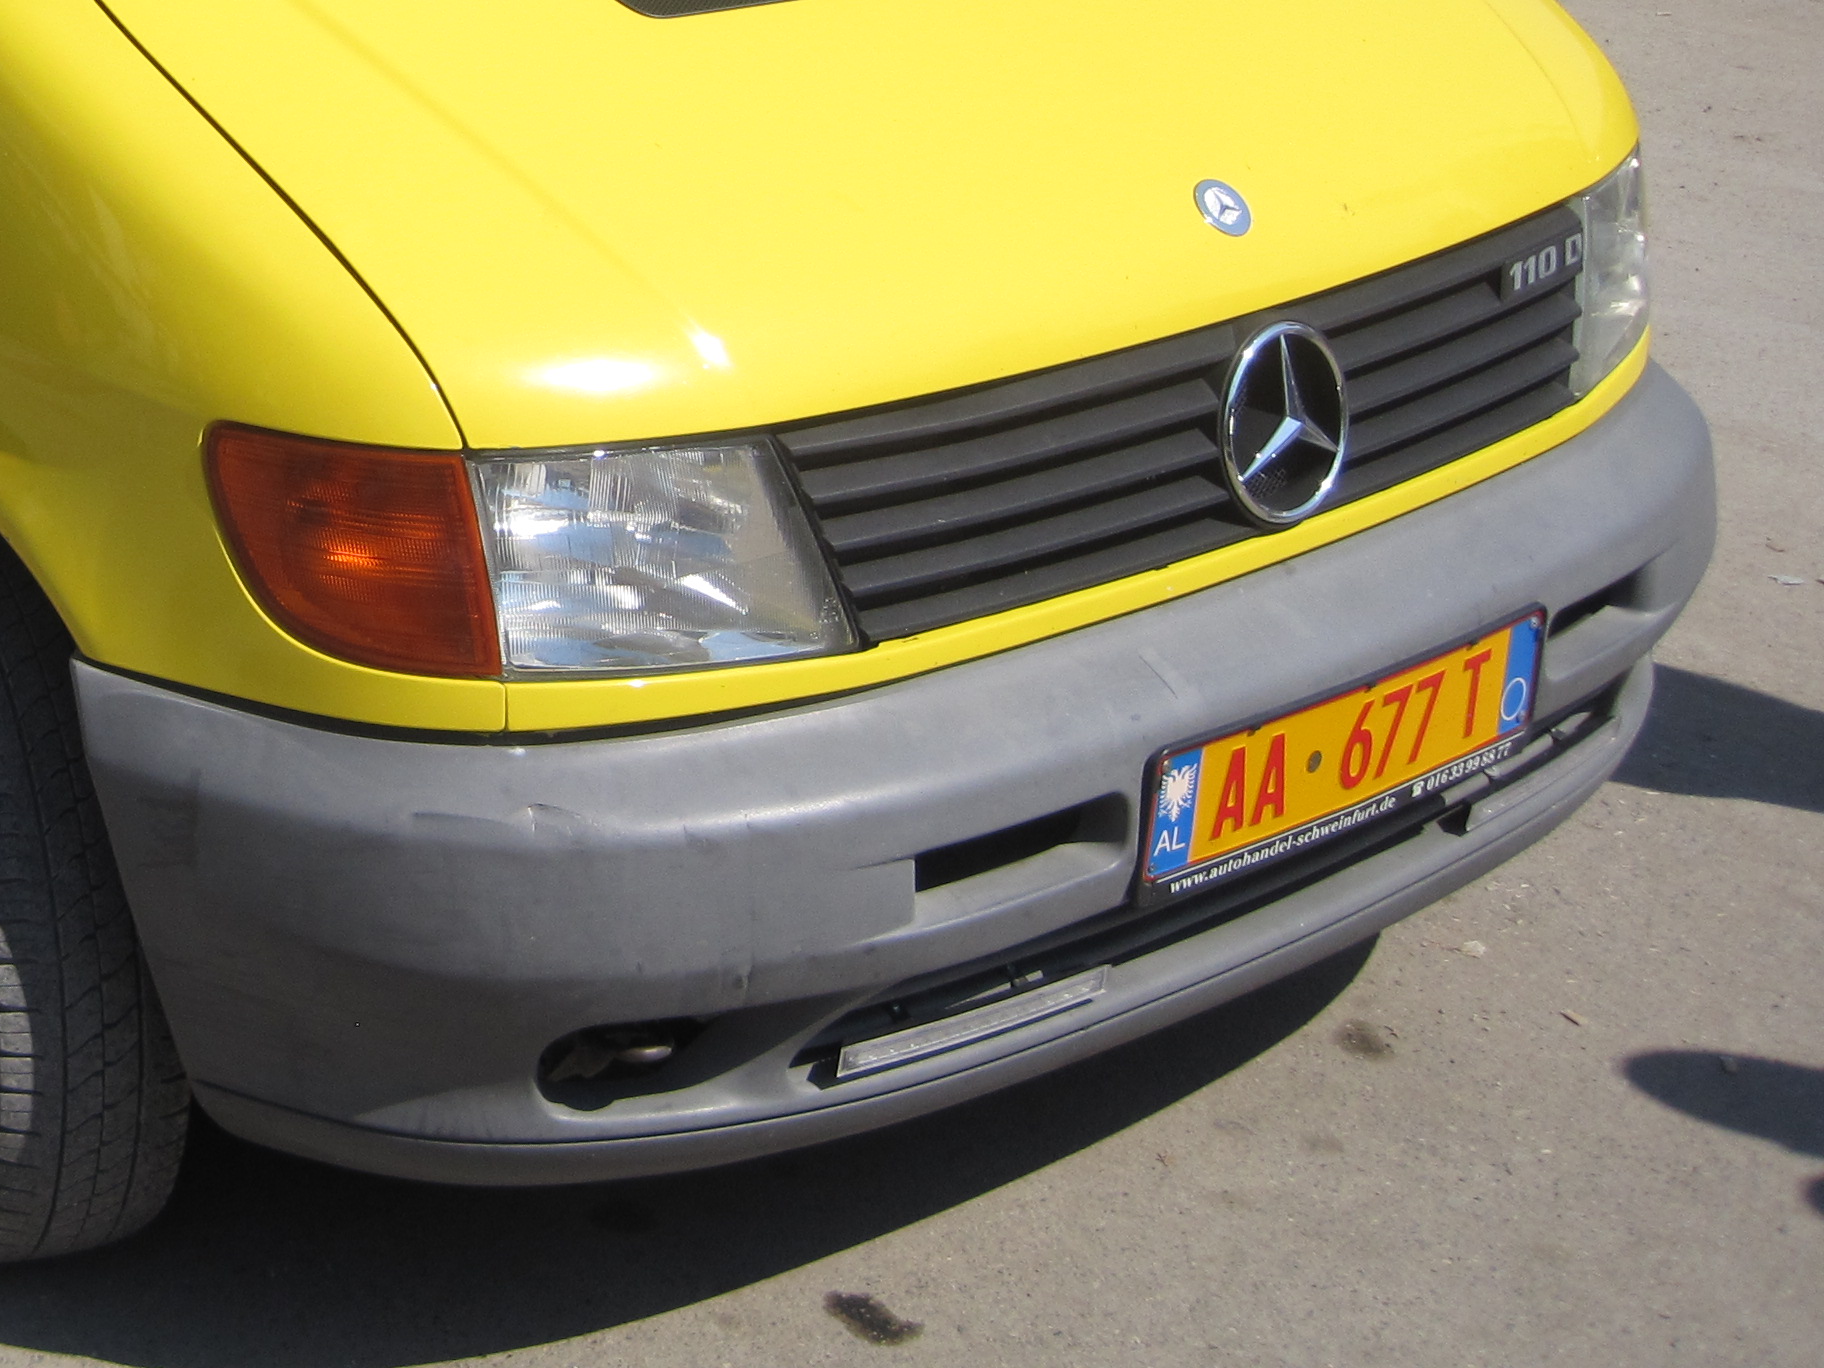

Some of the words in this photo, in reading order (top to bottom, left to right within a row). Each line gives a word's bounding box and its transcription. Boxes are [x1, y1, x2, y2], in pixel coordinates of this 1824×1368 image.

[1509, 245, 1557, 291] 110
[1564, 232, 1582, 267] D
[1208, 732, 1286, 841] AA
[1339, 668, 1448, 790] 677
[1462, 647, 1493, 739] T
[1153, 826, 1186, 857] AL
[1169, 794, 1397, 894] www.autohandel-schweinfurt.de
